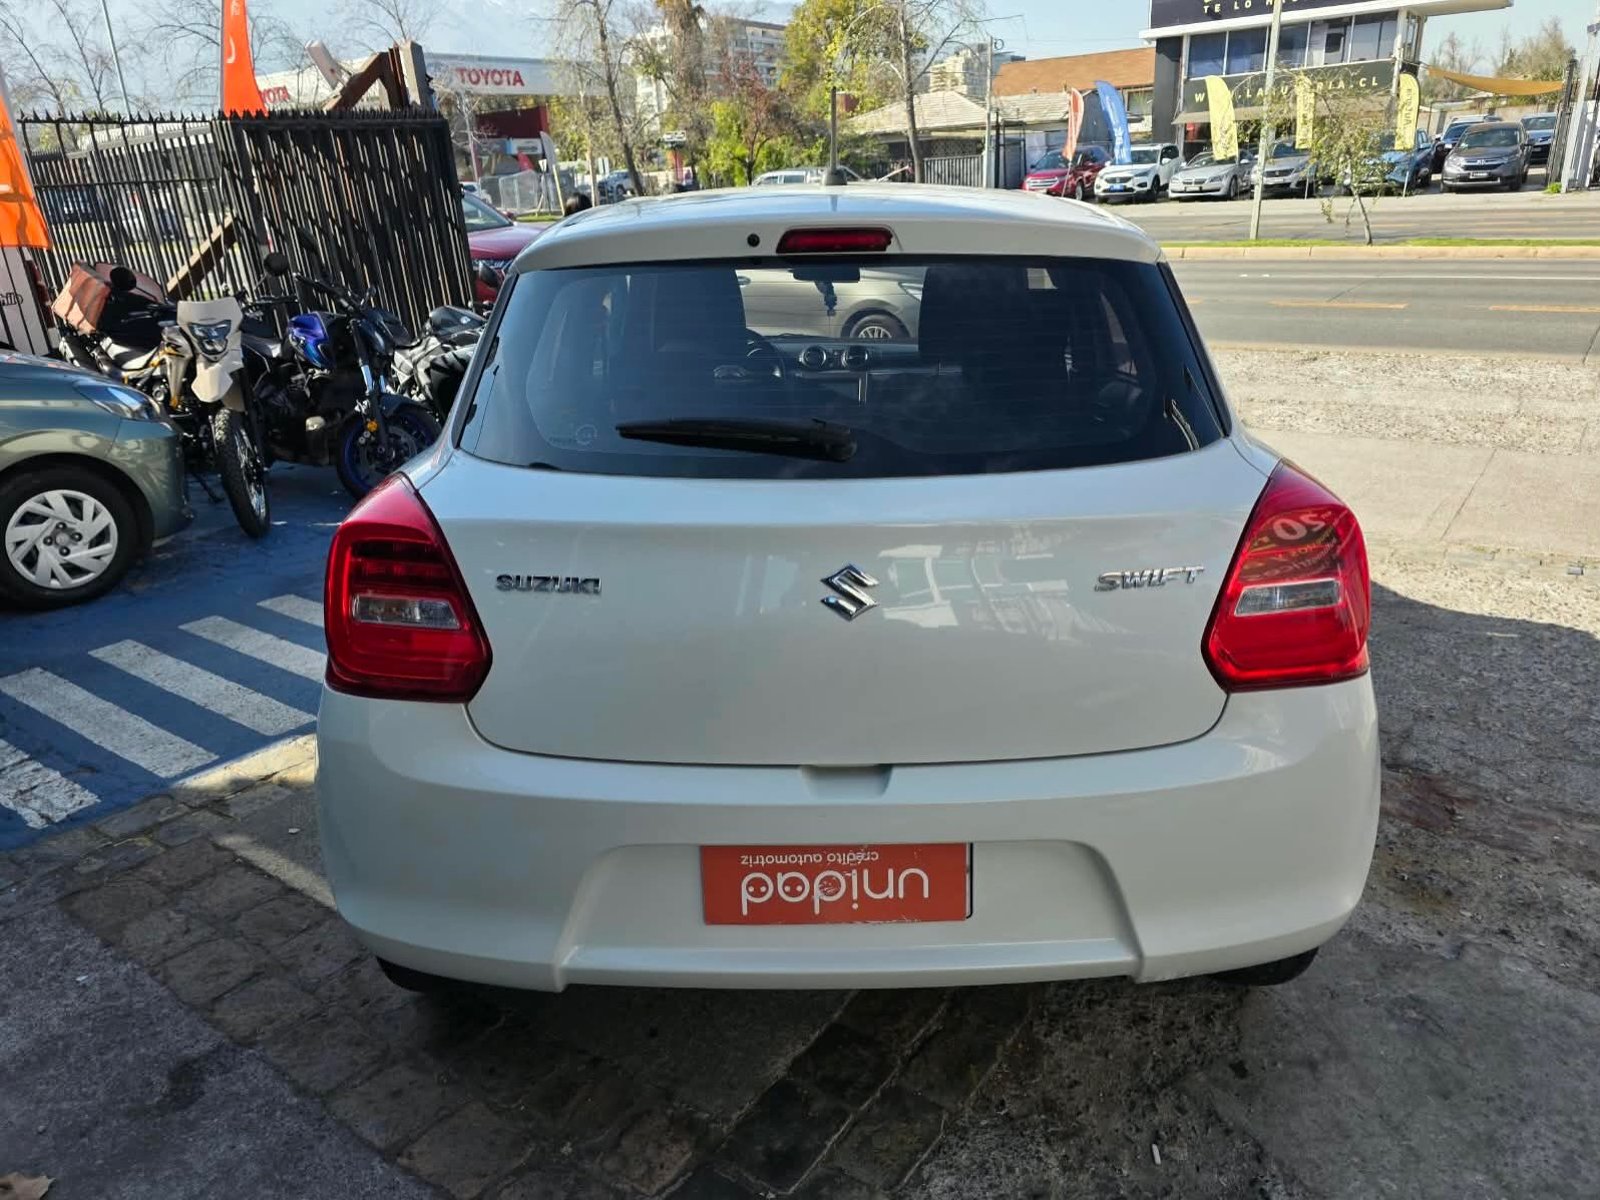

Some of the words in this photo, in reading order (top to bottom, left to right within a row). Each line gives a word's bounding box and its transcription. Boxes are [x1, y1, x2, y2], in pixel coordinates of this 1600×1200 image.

[1203, 3, 1221, 14] TE
[1234, 0, 1252, 10] LO
[457, 68, 525, 87] TOYOTA
[261, 85, 291, 104] YOTA
[496, 574, 602, 594] SUZUKI
[1094, 565, 1205, 592] SWIFT
[740, 853, 823, 867] automotriz
[827, 851, 880, 866] crédito
[741, 868, 930, 916] unidad
